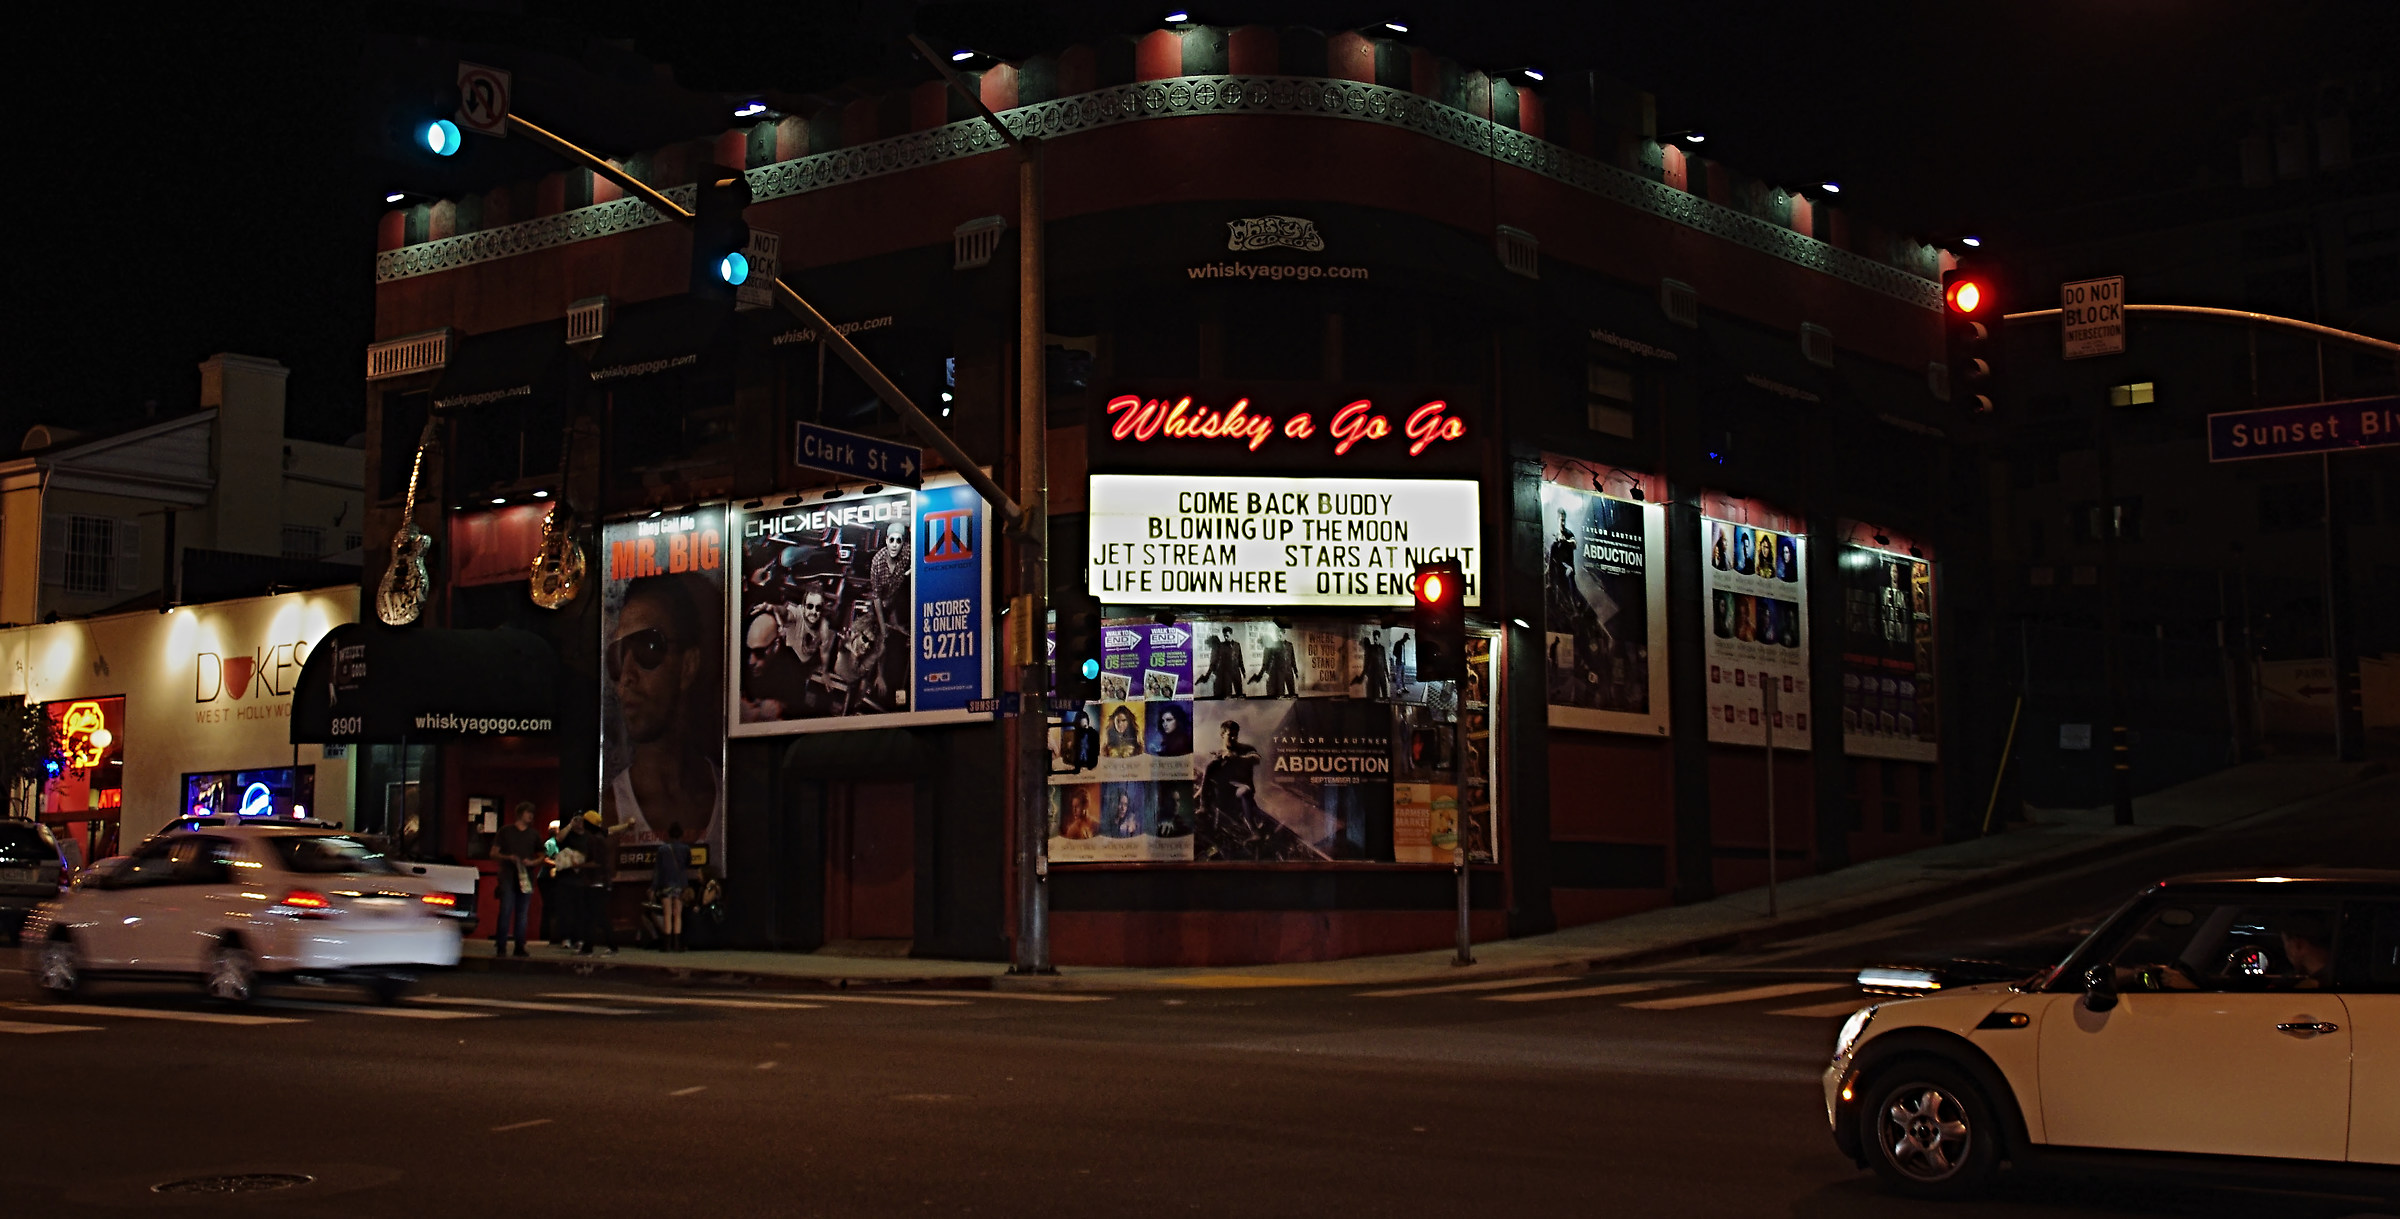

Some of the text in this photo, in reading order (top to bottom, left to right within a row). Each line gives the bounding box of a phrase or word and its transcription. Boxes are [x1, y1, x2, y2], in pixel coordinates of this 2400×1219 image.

[755, 234, 778, 254] NOT
[749, 255, 775, 277] OCK
[1187, 261, 1369, 281] whiskyagogo.com
[2066, 282, 2119, 305] DO NOT
[2066, 304, 2120, 326] BLOCK
[2066, 325, 2121, 341] INTERSECTION
[1589, 327, 1679, 361] whiskyagogo.com
[589, 353, 698, 382] whiskyagogo.com
[434, 384, 532, 410] whiskyagogo.com
[1107, 394, 1468, 457] Whisky a Go Go
[2232, 409, 2400, 448] Sunset Bl
[804, 434, 888, 472] Clark St
[1179, 492, 1392, 515] COME BACK BUDDY
[638, 516, 695, 538] They Call Me
[744, 501, 908, 538] CHICKENFOOT
[1149, 517, 1408, 542] BLOWING UP THE MOON
[611, 528, 720, 581] MR. BIG
[1094, 543, 1135, 565] JET
[1143, 544, 1236, 566] STREAM
[1285, 545, 1360, 568] STARS
[1368, 547, 1398, 568] AT
[1583, 543, 1643, 568] ABDUCTION
[1103, 570, 1152, 592] LIFE
[1162, 571, 1222, 593] DOWN
[1230, 571, 1287, 593] HERE
[1317, 572, 1368, 595] OTIS
[923, 599, 971, 618] IN STORES
[923, 615, 968, 633] & ONLINE
[923, 631, 974, 660] 9.27.11
[1106, 636, 1129, 644] END
[1151, 634, 1176, 642] END
[1308, 644, 1336, 656] DO YOU
[1150, 656, 1166, 667] US
[1311, 656, 1336, 669] STAND
[1319, 669, 1336, 682] COM
[196, 703, 291, 723] WEST HOLLYWO
[969, 700, 1000, 712] SUNSET
[331, 716, 363, 736] 8901
[414, 713, 552, 735] whiskyagogo.com
[1273, 736, 1325, 744] TAYLOR
[1273, 756, 1389, 773] ABDUCTION
[1310, 776, 1351, 784] SEPTEMBER
[1395, 808, 1430, 817] FARMERS
[1395, 817, 1430, 827] MARKET
